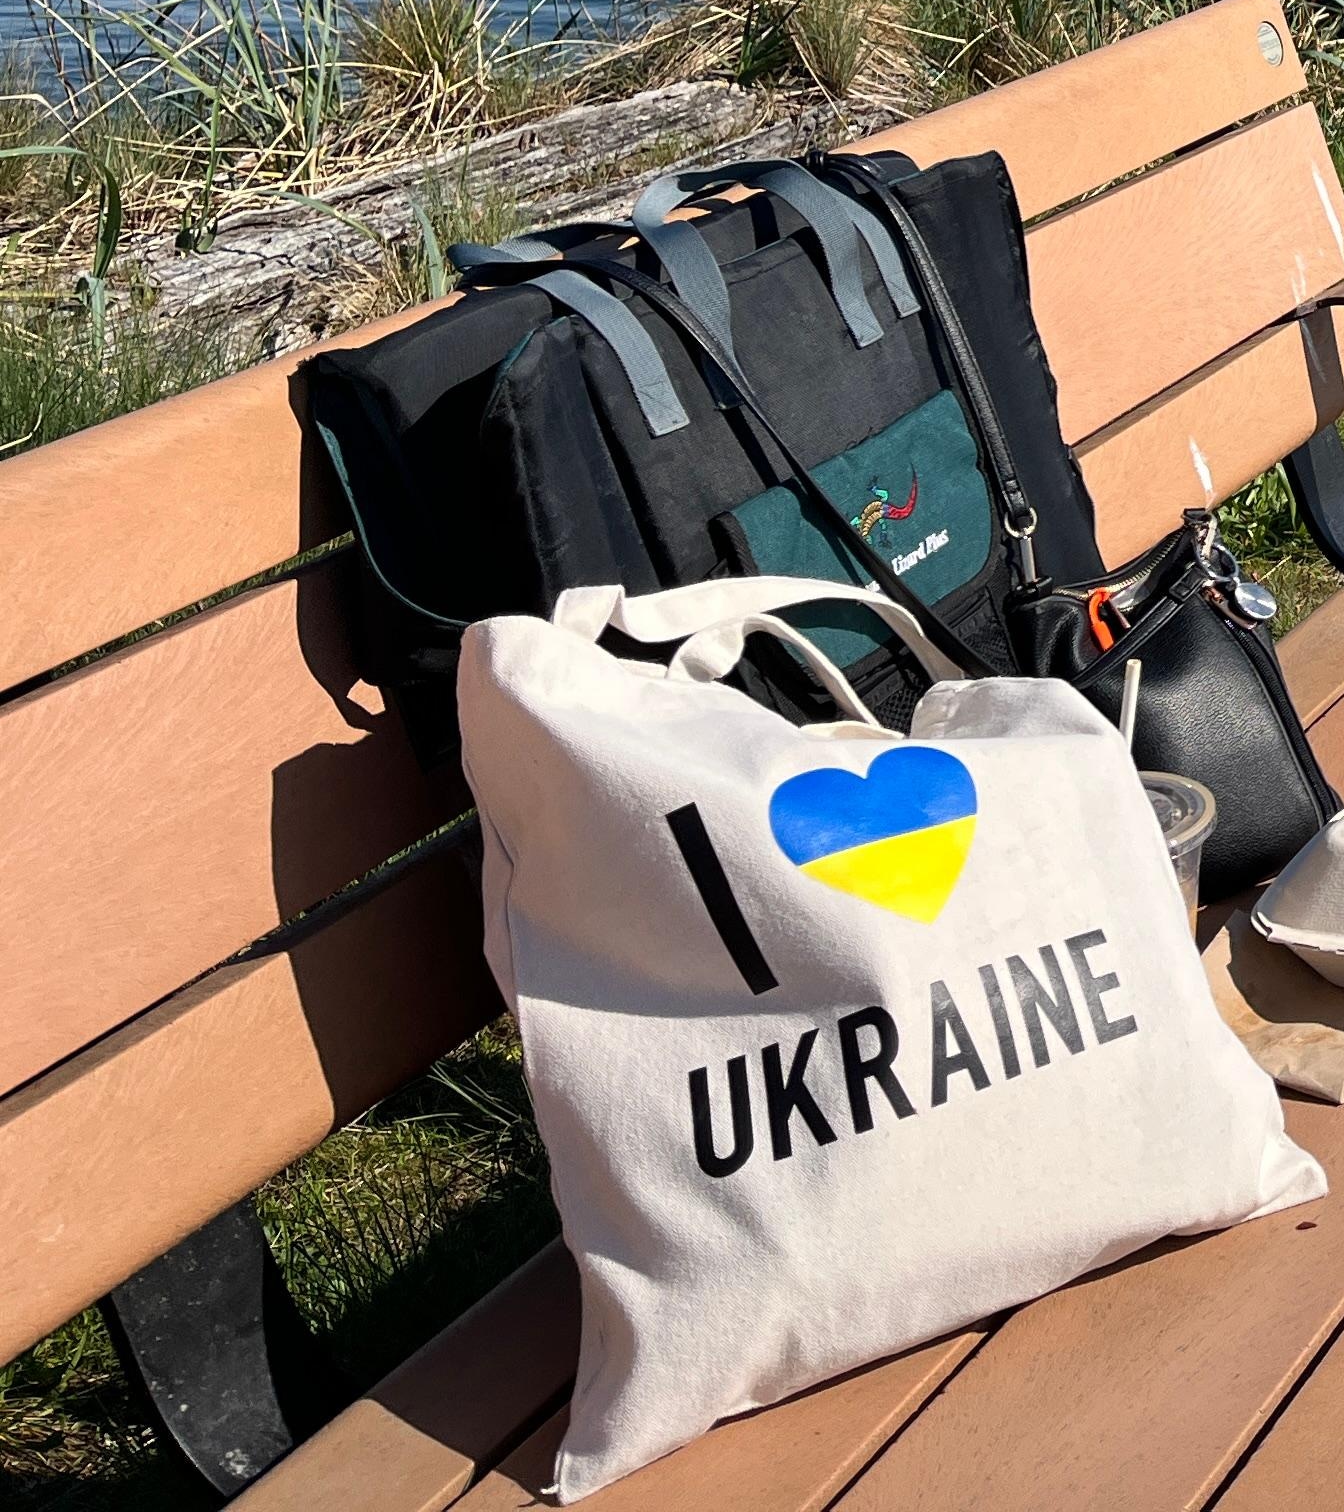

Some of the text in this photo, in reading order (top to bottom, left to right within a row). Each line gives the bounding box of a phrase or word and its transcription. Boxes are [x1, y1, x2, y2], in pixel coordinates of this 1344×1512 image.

[891, 529, 950, 576] Lizard Plus
[665, 801, 779, 996] I
[688, 929, 1138, 1178] UKRAINE
